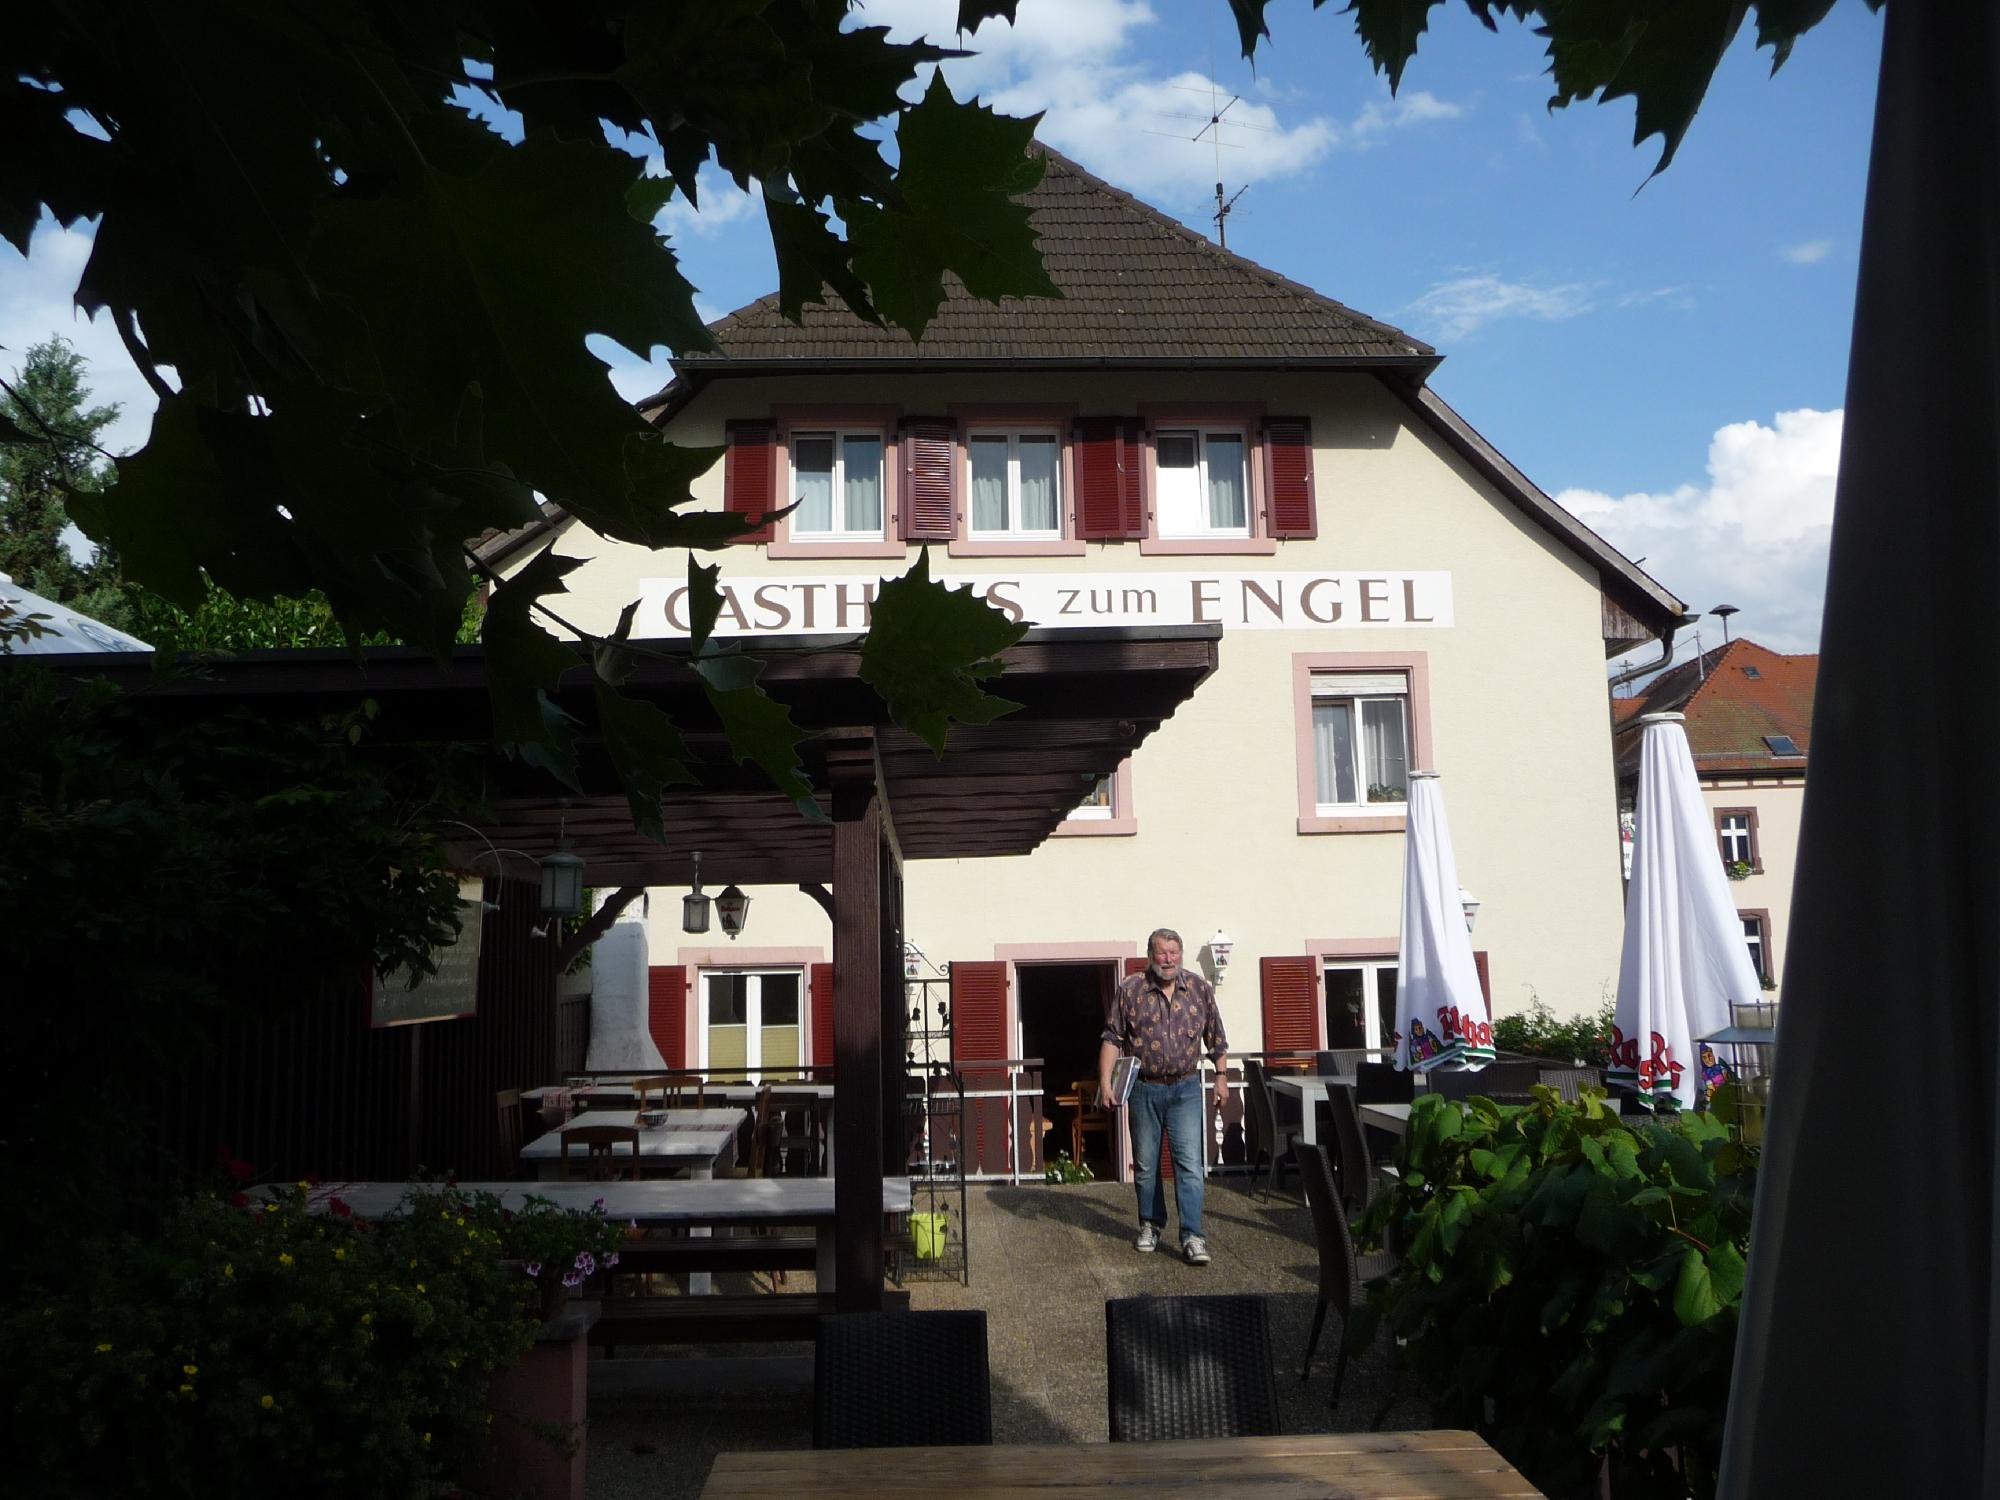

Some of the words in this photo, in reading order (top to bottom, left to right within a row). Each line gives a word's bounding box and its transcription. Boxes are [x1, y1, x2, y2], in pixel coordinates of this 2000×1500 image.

[664, 581, 1024, 632] GASTHS
[1057, 588, 1158, 615] zum
[1189, 578, 1434, 624] ENGEL
